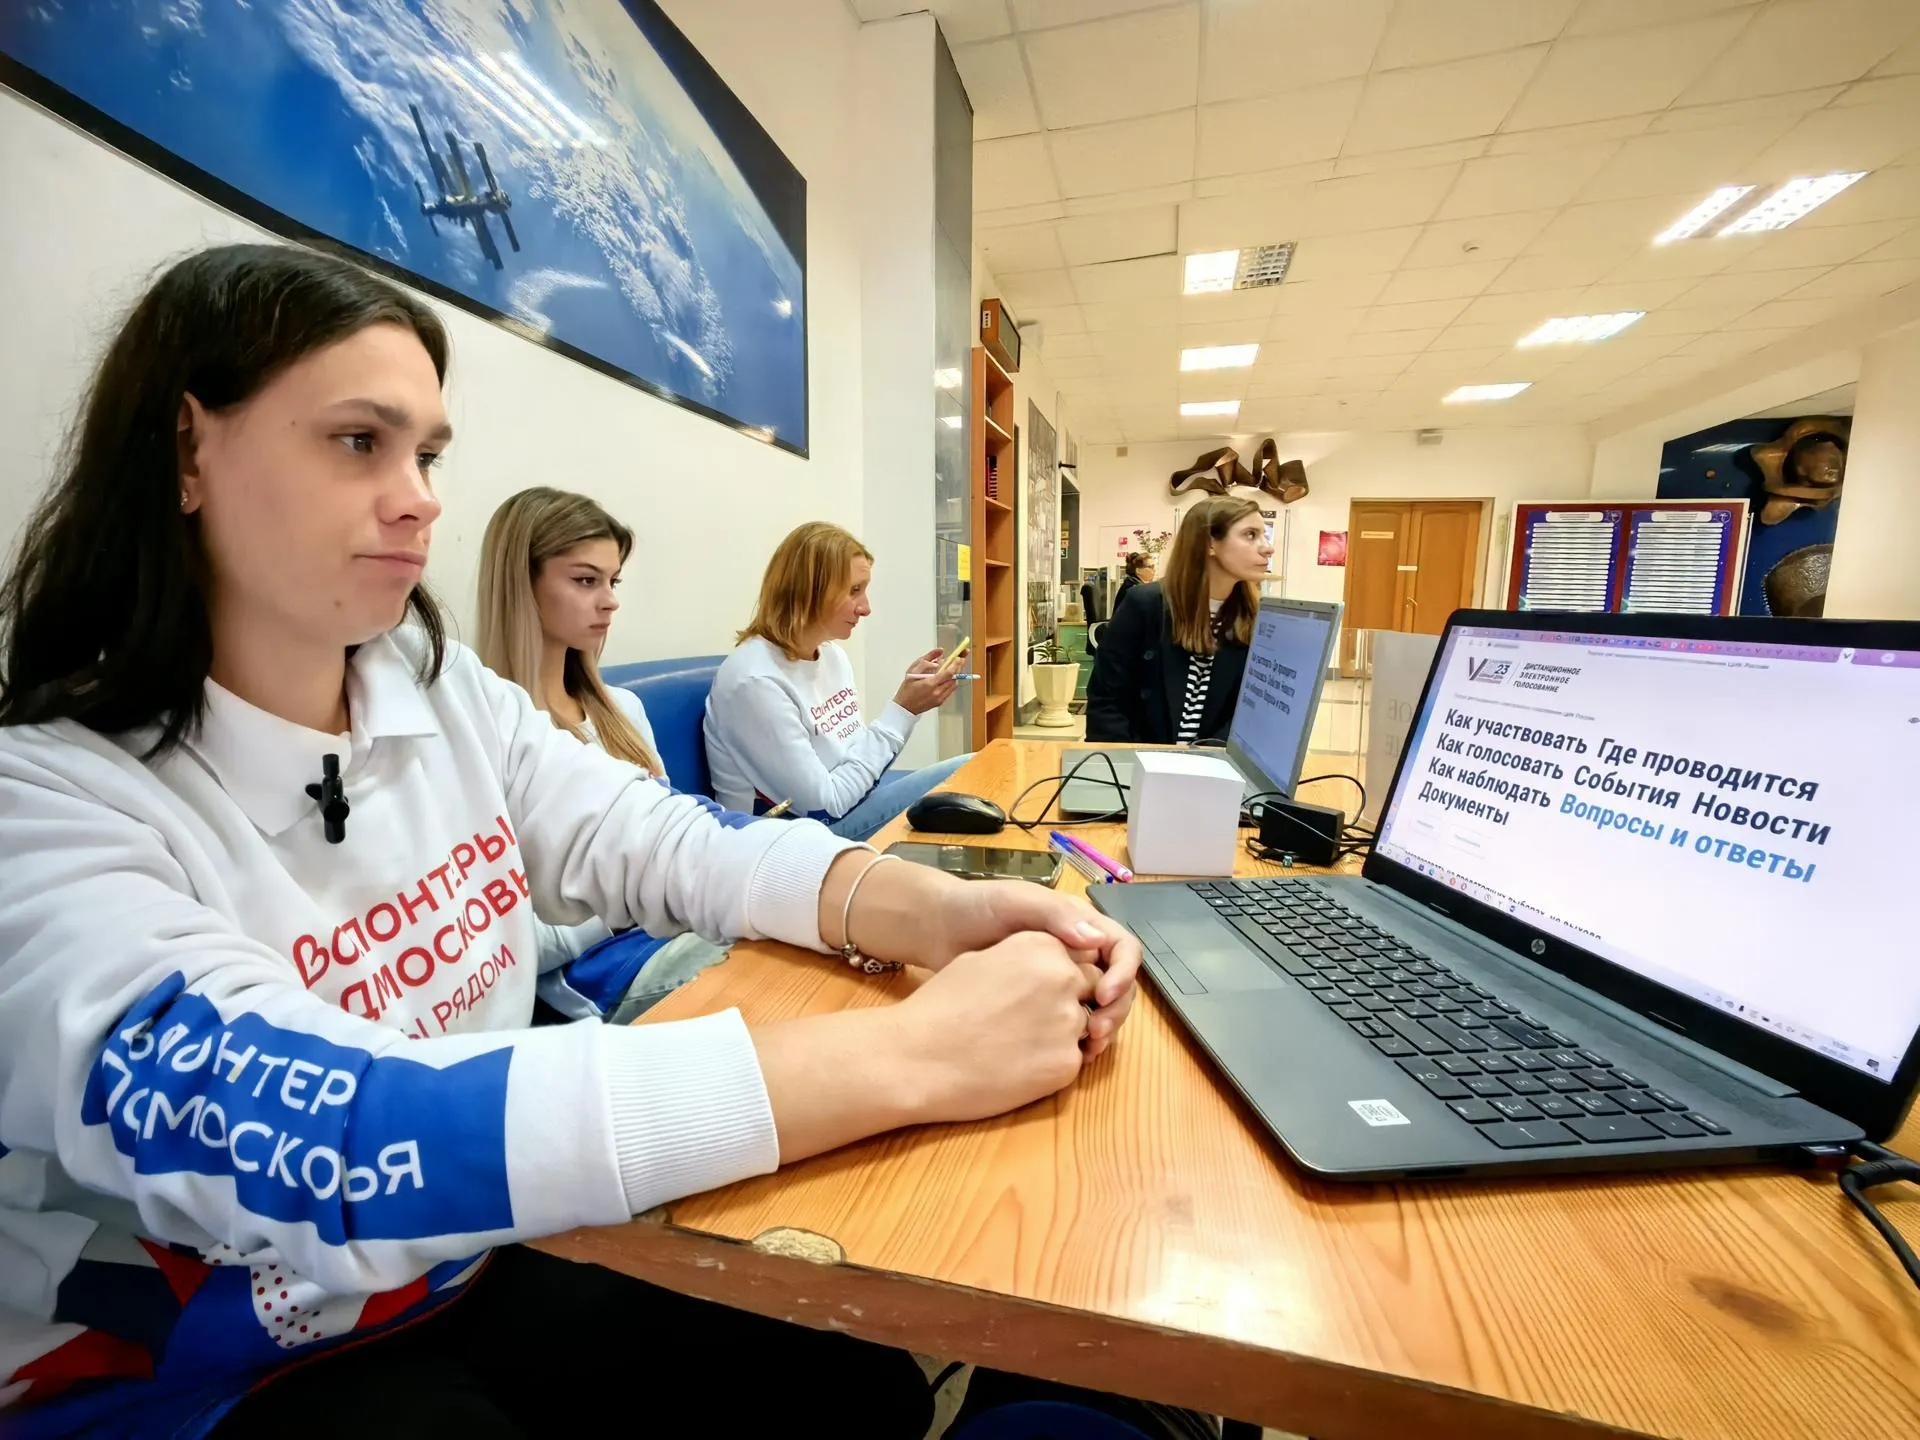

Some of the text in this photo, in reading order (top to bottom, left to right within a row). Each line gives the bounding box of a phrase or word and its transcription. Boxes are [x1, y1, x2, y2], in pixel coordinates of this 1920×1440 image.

[1513, 680, 1559, 692] ГОЛОСОВАНИЕ
[1519, 672, 1570, 684] ЭЛЕКТРОННОЕ
[1523, 662, 1581, 675] ДИСТАНЦИОННОЕ
[1445, 708, 1473, 729] Как
[1474, 718, 1588, 754] участвовать
[1597, 738, 1637, 766] Где
[1641, 751, 1819, 802] проводится
[1417, 781, 1510, 825] Документы
[1428, 757, 1816, 883] Как наблюдать Вопросы и ответы
[1436, 732, 1464, 754] Как
[1465, 743, 1564, 780] голосовать
[1573, 765, 1680, 809] События
[1692, 791, 1832, 846] Новости
[432, 944, 516, 1032] РЯДОМ
